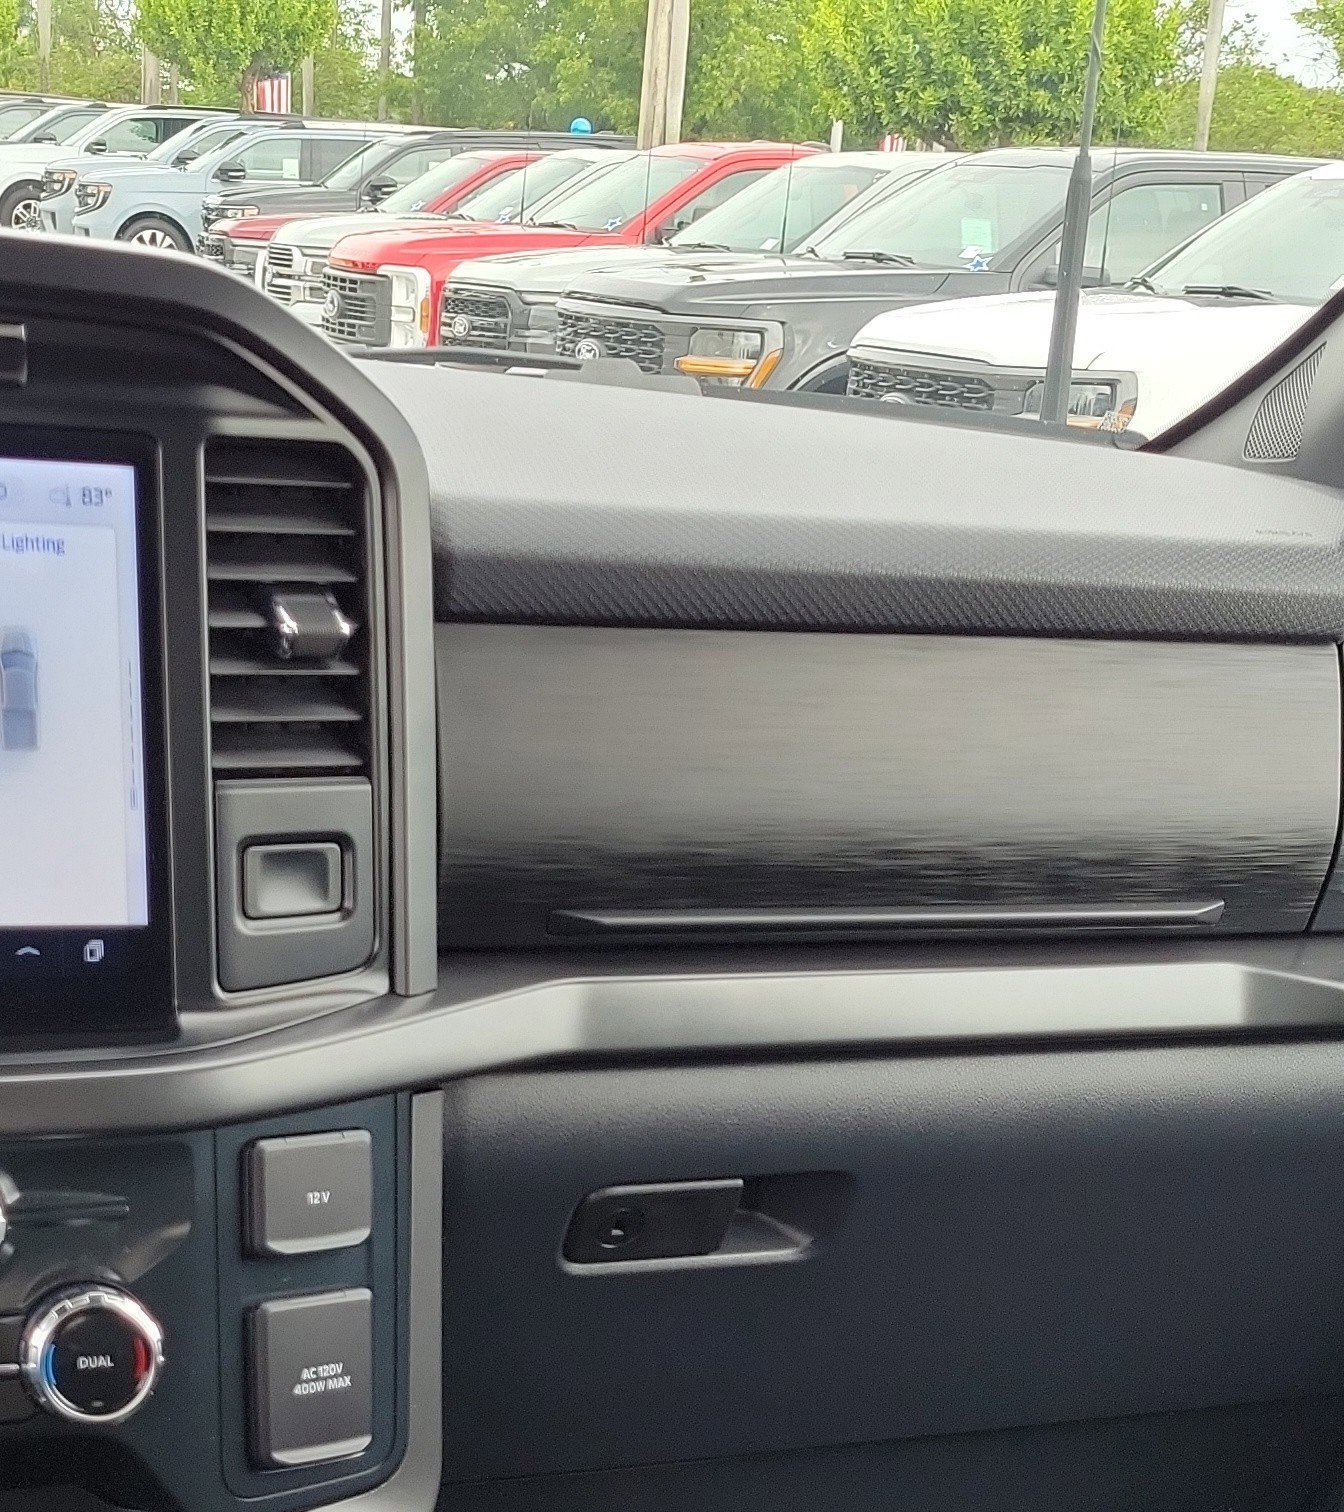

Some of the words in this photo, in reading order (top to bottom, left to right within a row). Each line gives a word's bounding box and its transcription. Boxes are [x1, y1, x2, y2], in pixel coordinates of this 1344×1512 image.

[2, 532, 65, 555] Lighting
[77, 1355, 115, 1369] DUAL
[301, 1368, 318, 1380] AC
[318, 1362, 343, 1378] 120V
[293, 1379, 326, 1395] 400W
[326, 1375, 351, 1391] MAX
